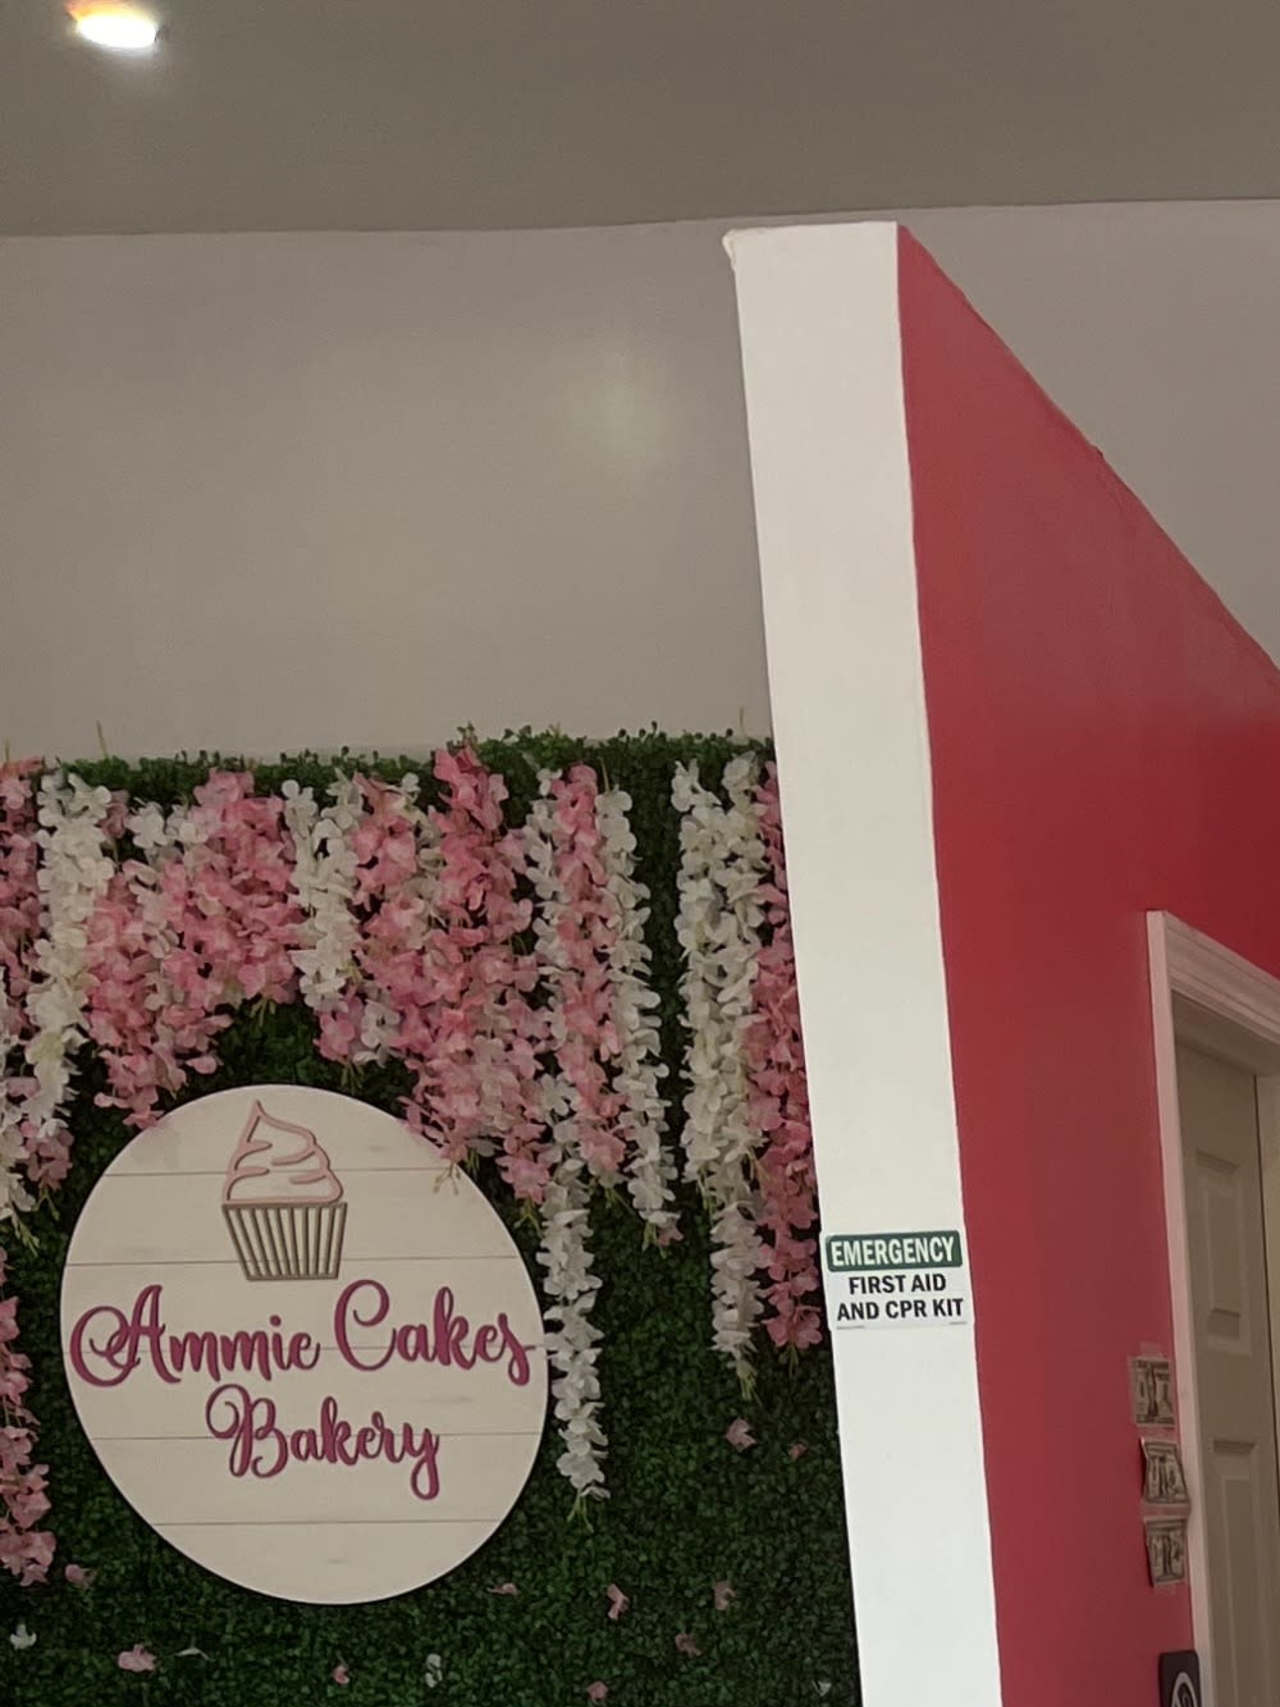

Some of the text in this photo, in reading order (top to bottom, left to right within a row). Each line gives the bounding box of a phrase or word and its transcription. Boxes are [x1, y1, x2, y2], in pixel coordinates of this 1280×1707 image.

[831, 1236, 955, 1266] EMERGENCY
[849, 1273, 947, 1295] FIRST AID
[837, 1298, 963, 1321] AND CPR KIT
[70, 1279, 536, 1387] Ammie Cakes
[206, 1384, 440, 1500] Bakery
